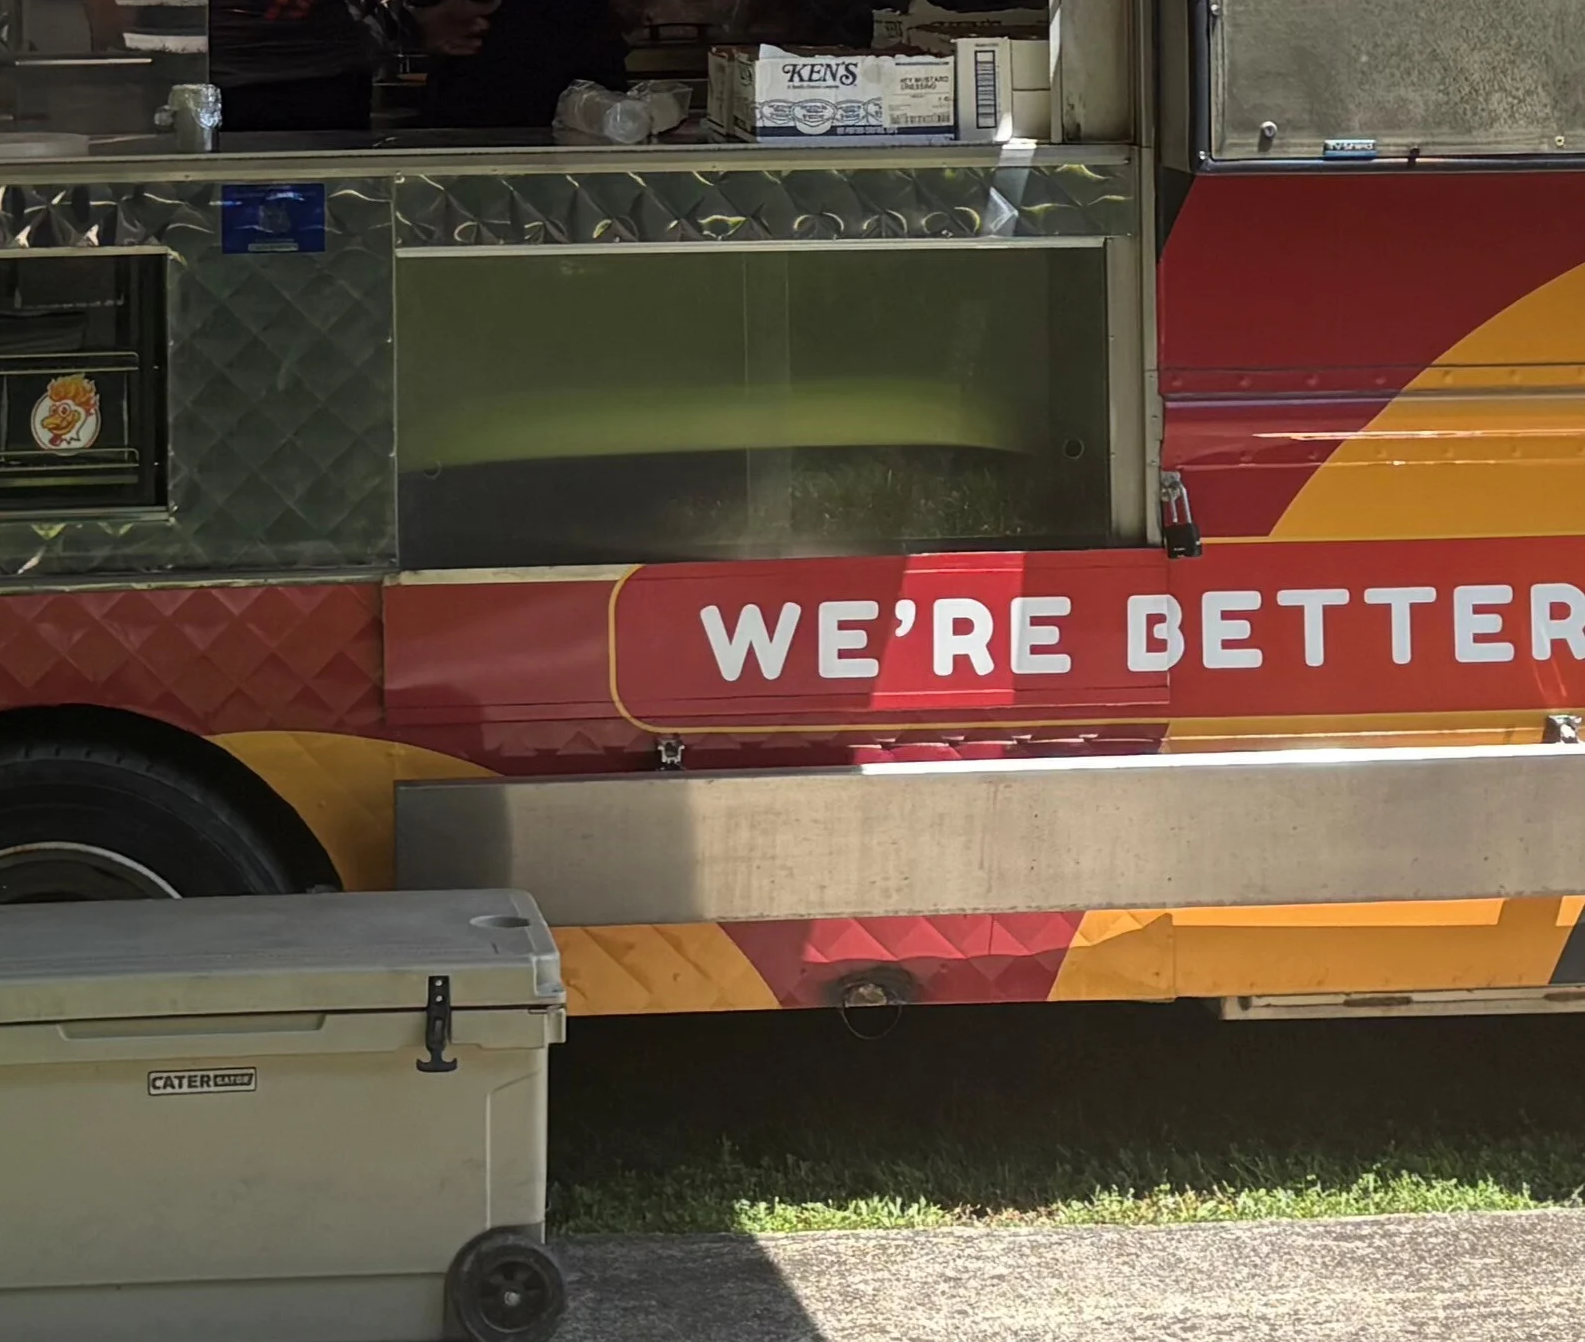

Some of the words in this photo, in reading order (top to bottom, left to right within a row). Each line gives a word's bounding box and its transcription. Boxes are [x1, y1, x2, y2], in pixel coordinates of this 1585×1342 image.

[782, 60, 859, 86] KEN'S
[699, 596, 1072, 682] WE'RE
[1126, 582, 1585, 672] BETTER
[150, 1074, 214, 1090] CATER
